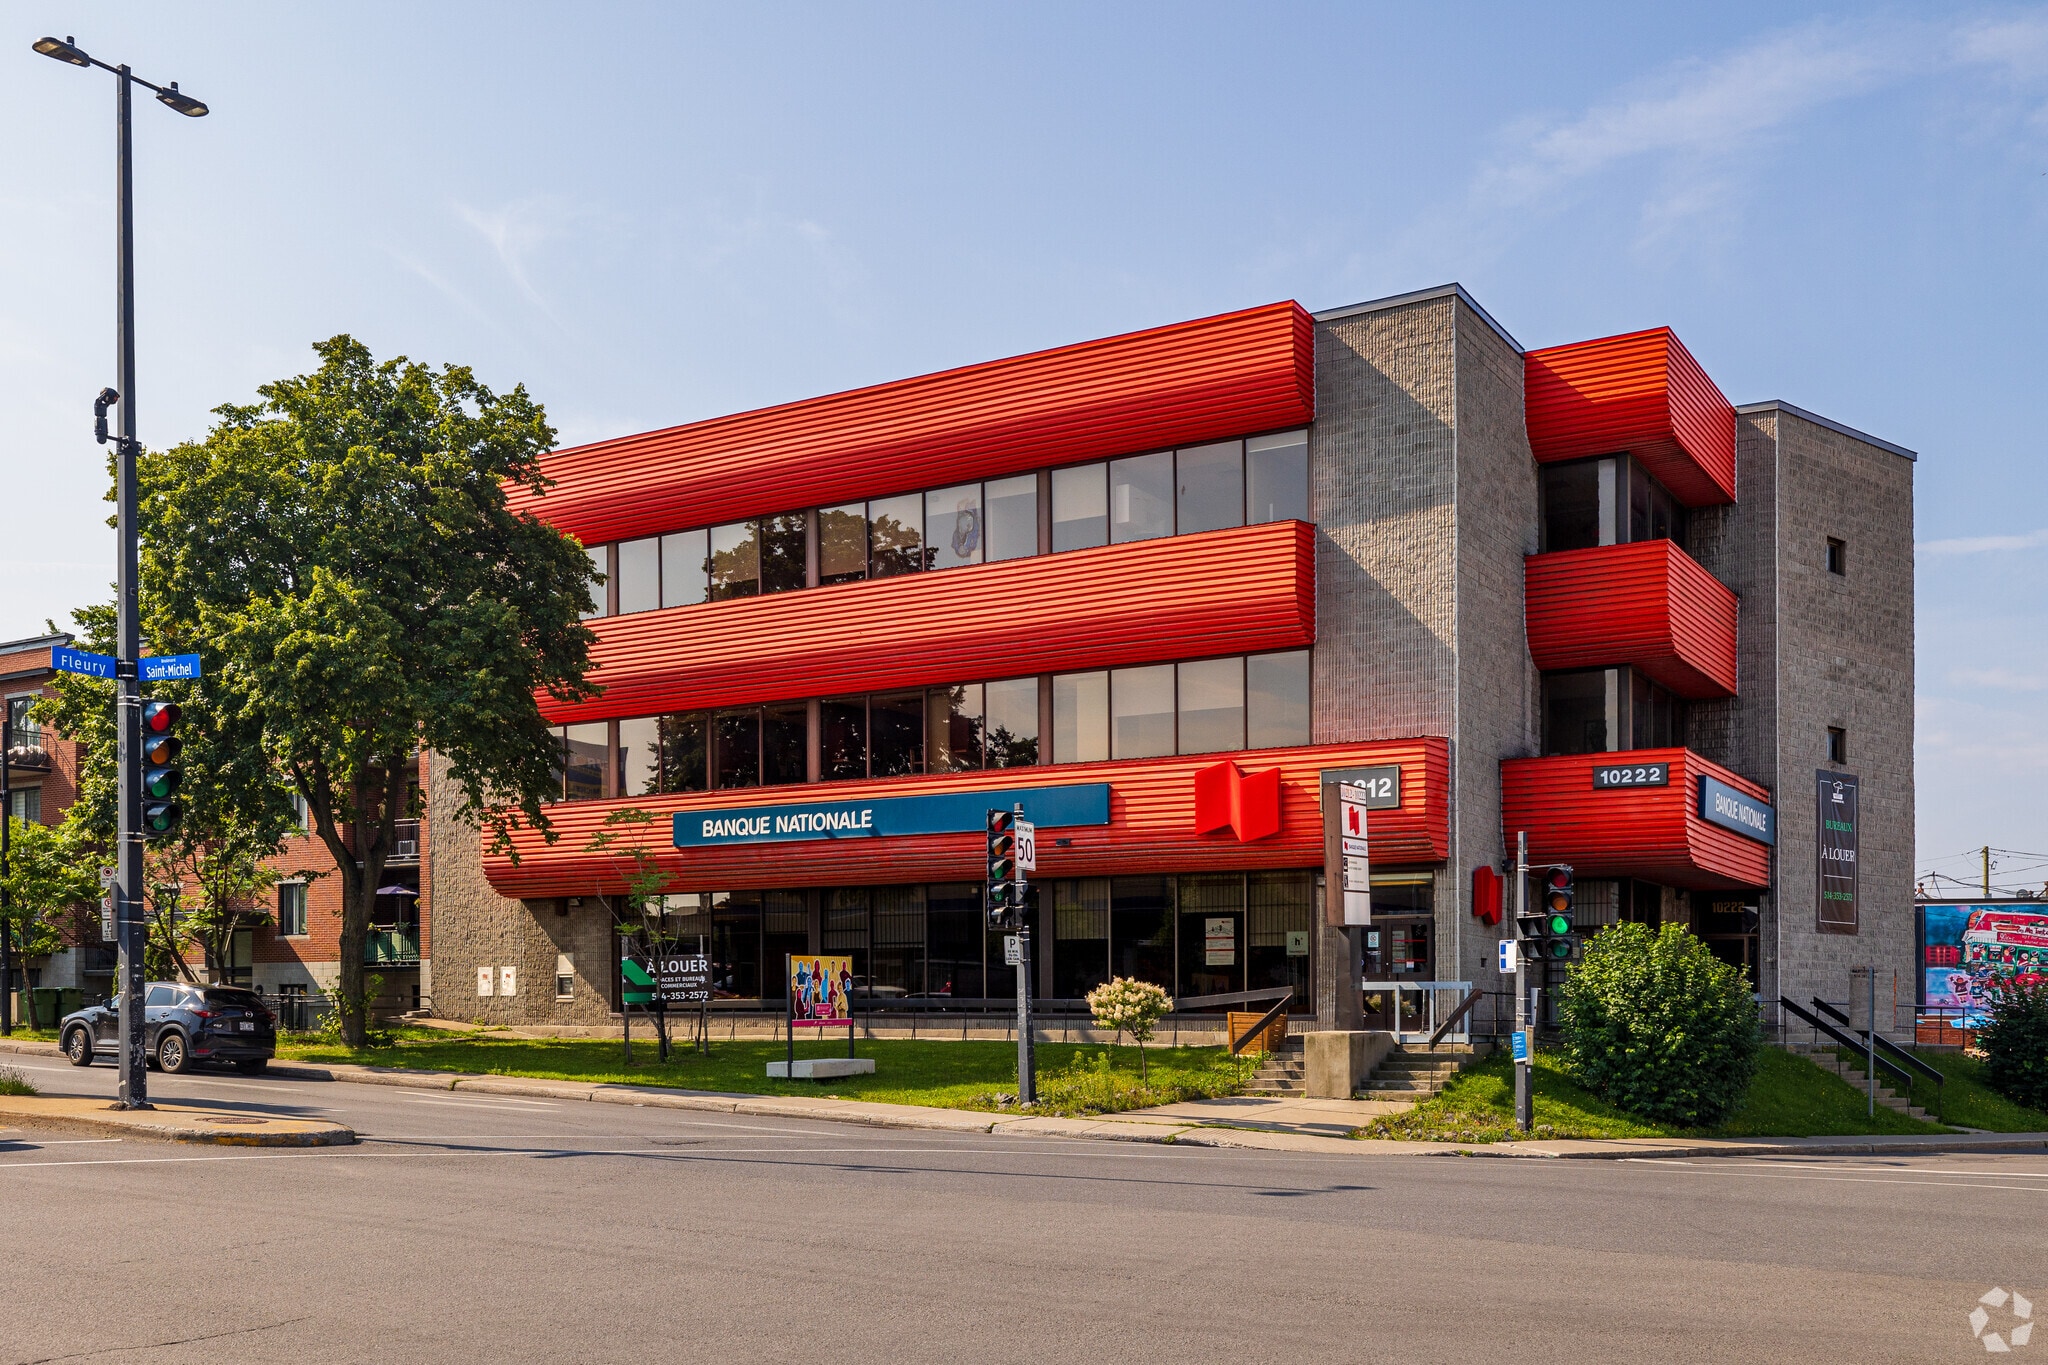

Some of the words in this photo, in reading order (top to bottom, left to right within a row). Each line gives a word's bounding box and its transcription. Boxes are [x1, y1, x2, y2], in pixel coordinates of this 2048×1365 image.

[61, 654, 106, 676] Fleury
[145, 662, 193, 678] Saint-Michel
[1600, 767, 1661, 785] 10222
[1715, 792, 1739, 820] BANQUE
[1738, 803, 1767, 833] NATIONALE
[702, 815, 771, 838] BANQUE
[775, 809, 873, 834] NATIONALE
[1825, 819, 1853, 832] BUREAUX
[1017, 836, 1033, 862] 50
[1821, 843, 1828, 859] À
[1829, 847, 1856, 862] LOUER
[1711, 901, 1745, 913] 10222
[1009, 938, 1016, 949] P
[646, 957, 657, 974] À
[660, 959, 709, 974] LOUER
[651, 990, 709, 1001] 54-353-2572
